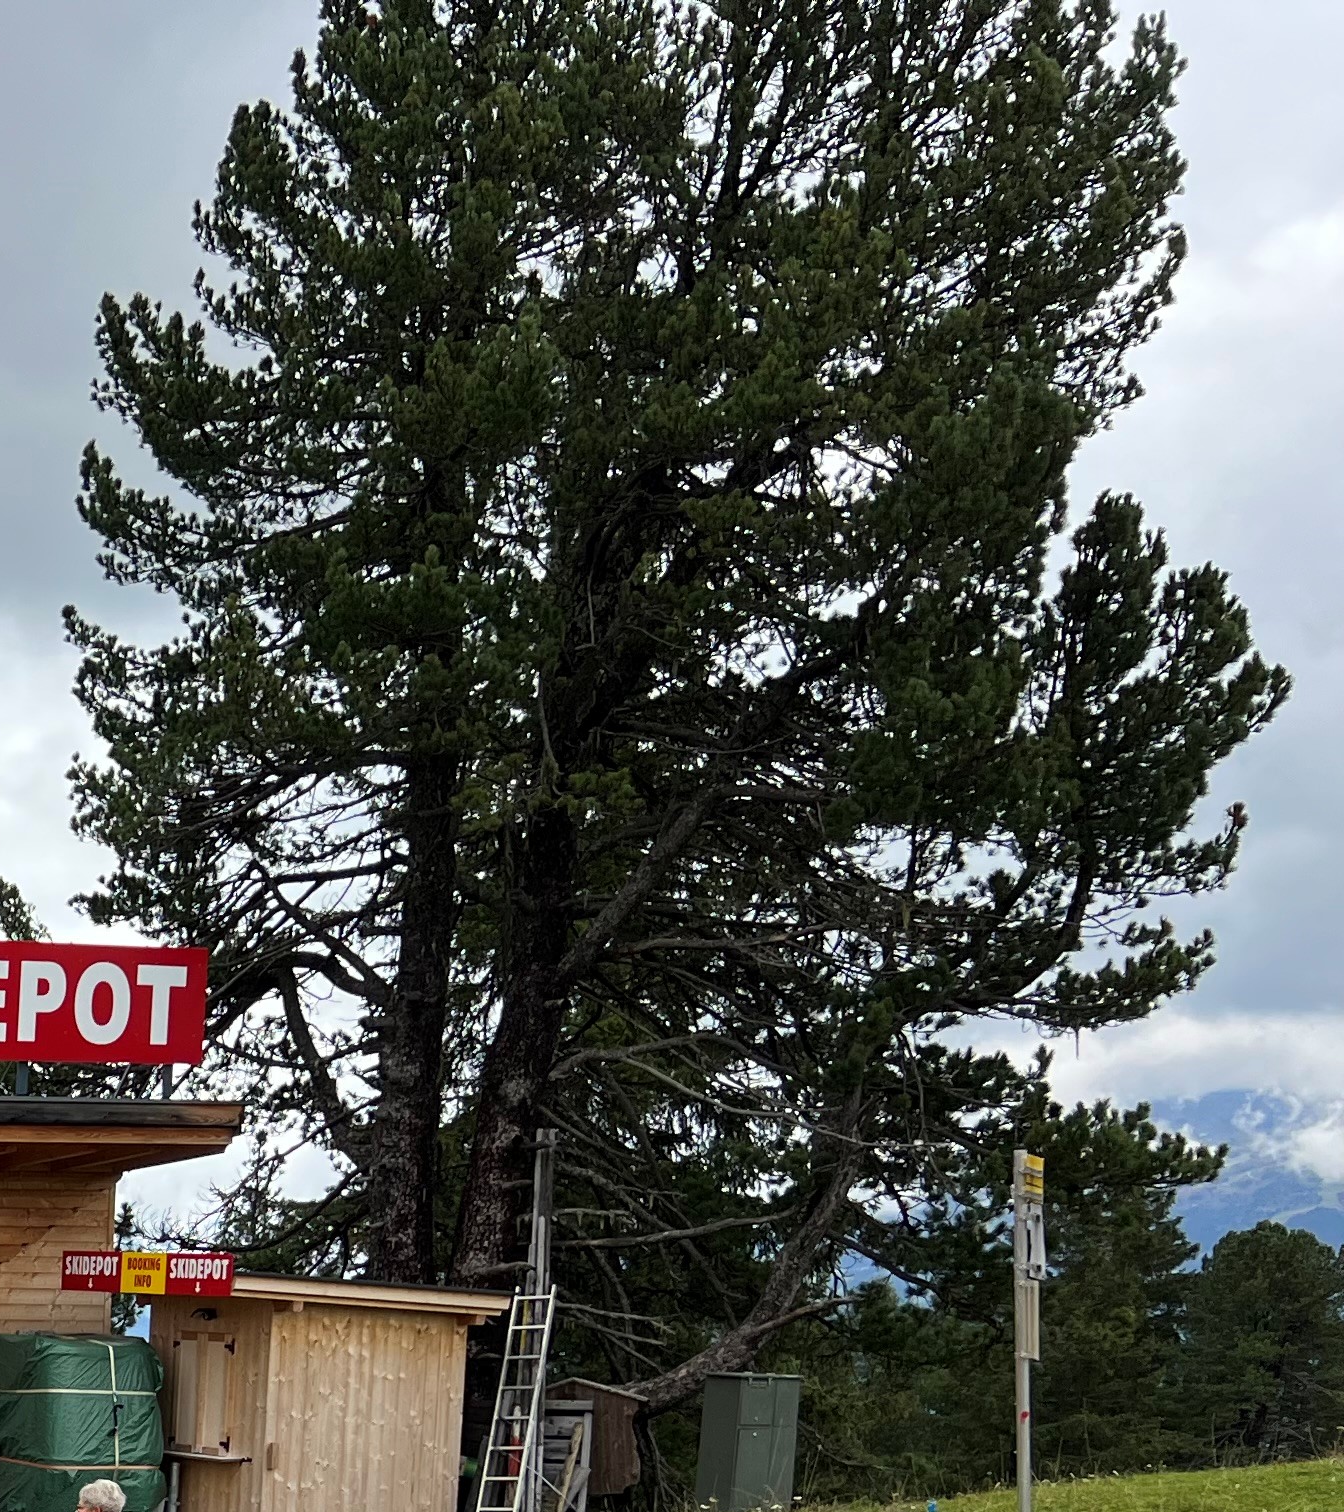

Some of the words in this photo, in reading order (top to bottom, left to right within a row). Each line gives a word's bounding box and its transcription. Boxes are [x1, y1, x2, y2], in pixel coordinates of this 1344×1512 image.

[65, 1255, 119, 1275] SKIDEPOT
[127, 1257, 161, 1271] BOOKING
[169, 1258, 230, 1280] SKIDEPOT
[134, 1274, 152, 1287] INFO
